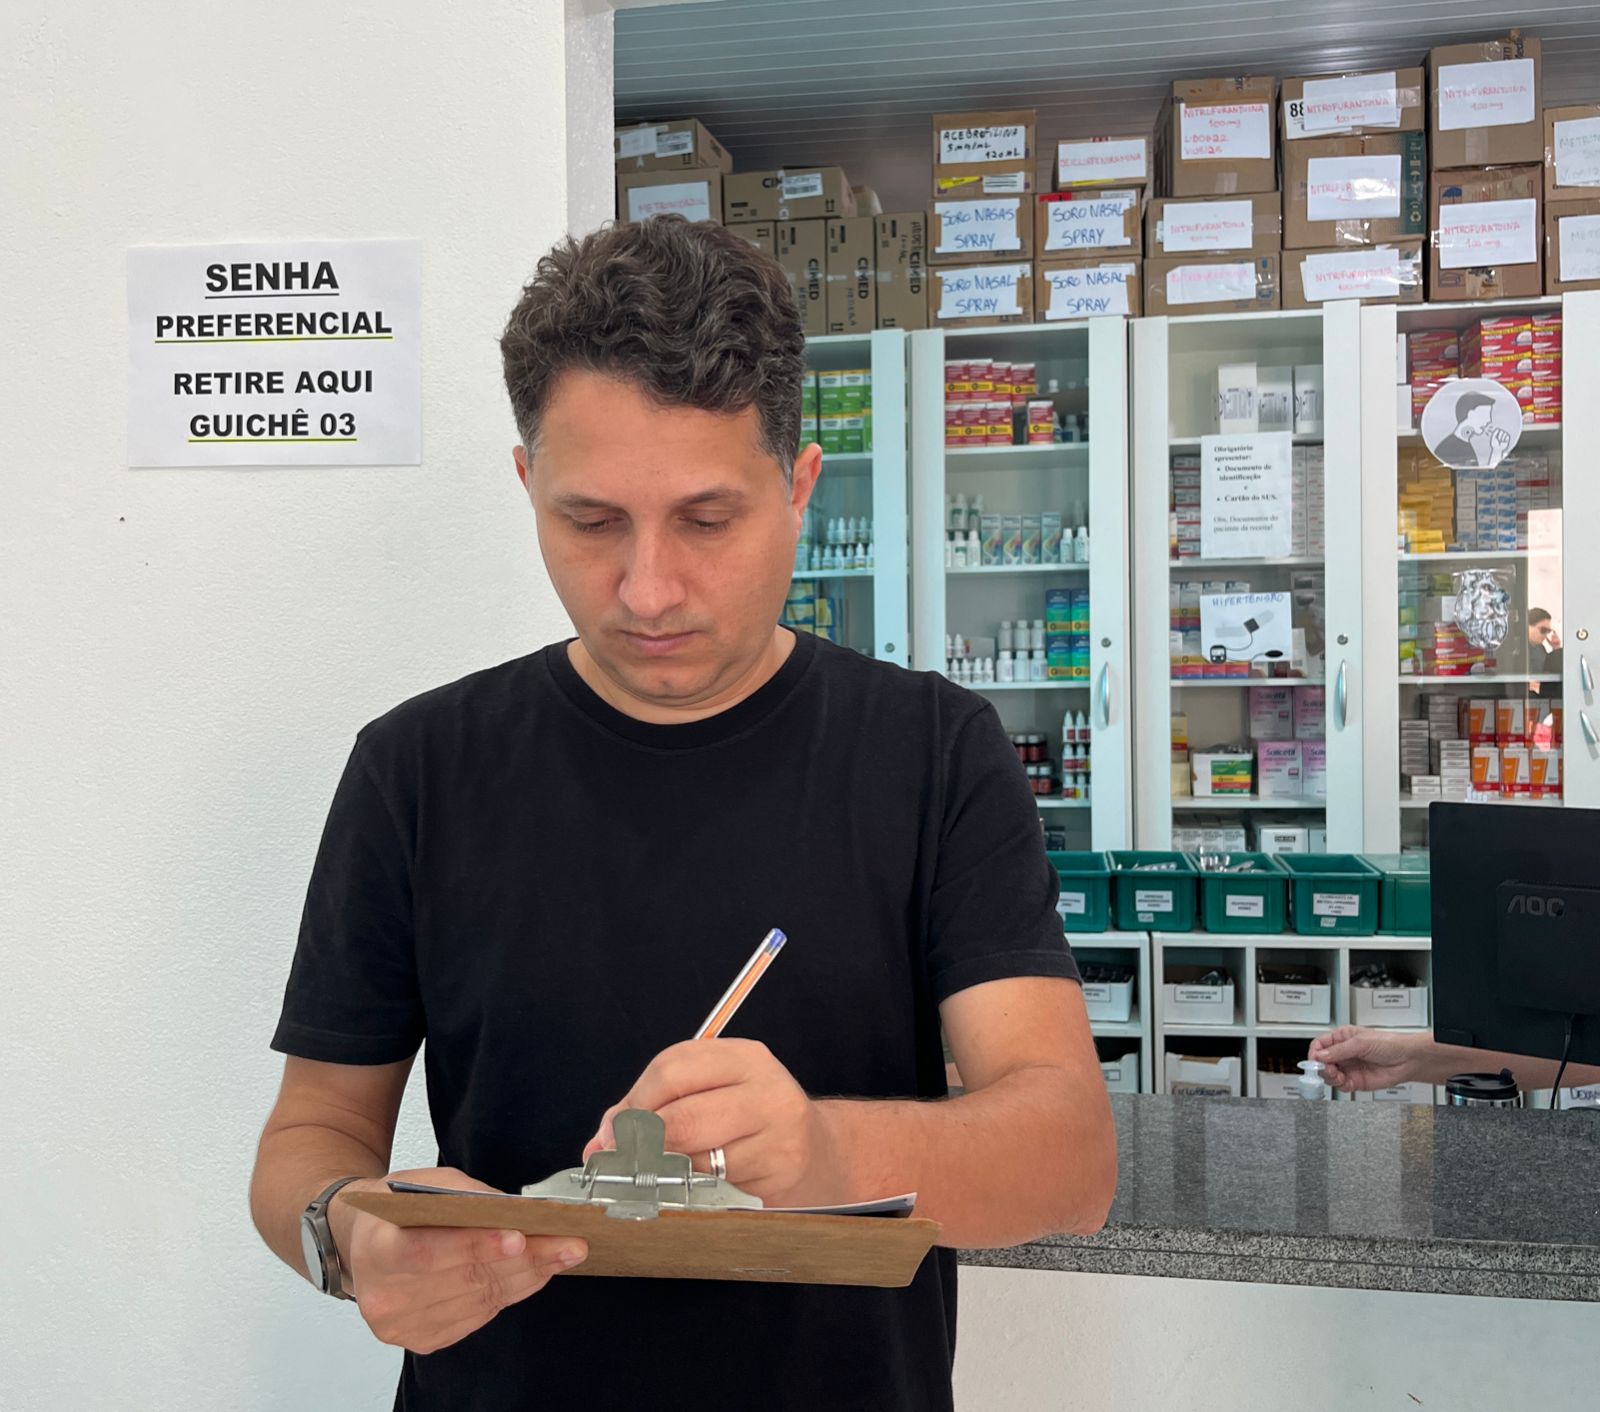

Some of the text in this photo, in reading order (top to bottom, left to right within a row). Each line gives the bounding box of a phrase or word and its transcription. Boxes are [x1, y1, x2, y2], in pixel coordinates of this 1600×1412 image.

[1089, 202, 1125, 218] NASAL
[954, 232, 996, 249] SPRAY
[1061, 228, 1104, 247] SPRAY
[205, 261, 339, 292] SENHA
[808, 258, 819, 300] CIMED
[857, 257, 869, 299] CIMED
[909, 251, 921, 294] CIMED
[974, 274, 1016, 290] NASAL
[1086, 271, 1127, 286] NASAL
[955, 298, 998, 313] SPRAY
[156, 311, 392, 338] PREFERENCIAL
[174, 370, 373, 395] RETIRE AQUI
[190, 408, 356, 437] GUICHÊ 03
[1507, 895, 1565, 917] AOC
